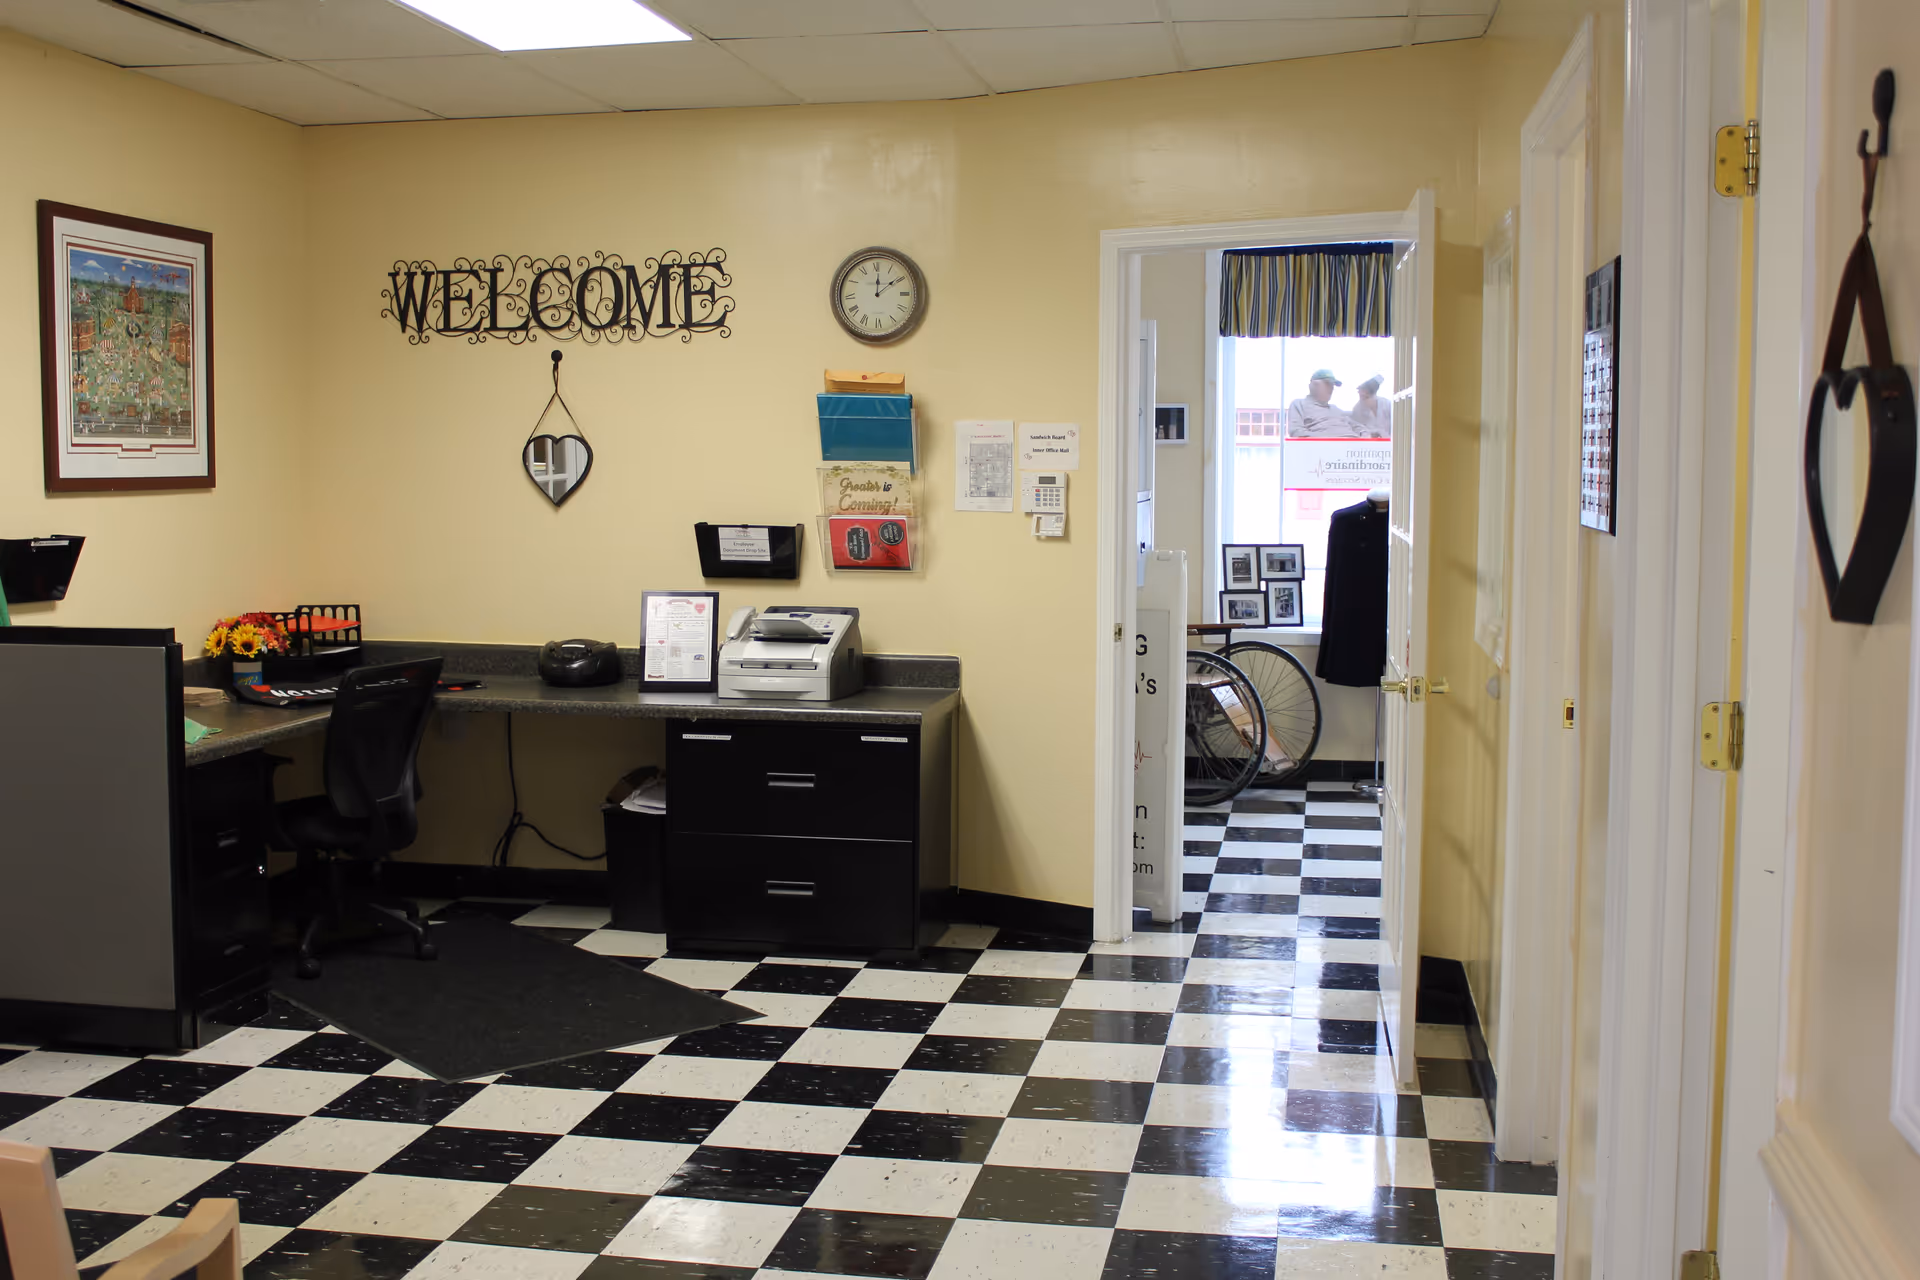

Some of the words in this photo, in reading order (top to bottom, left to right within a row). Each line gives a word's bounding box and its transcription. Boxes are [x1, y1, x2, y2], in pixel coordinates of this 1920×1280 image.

[386, 260, 732, 335] WELCOME
[839, 477, 881, 495] Greater
[883, 482, 893, 492] is
[838, 494, 898, 515] Coming!
[1136, 672, 1157, 695] 's
[1135, 804, 1148, 819] n
[1133, 832, 1145, 849] t:
[1133, 861, 1153, 875] om
